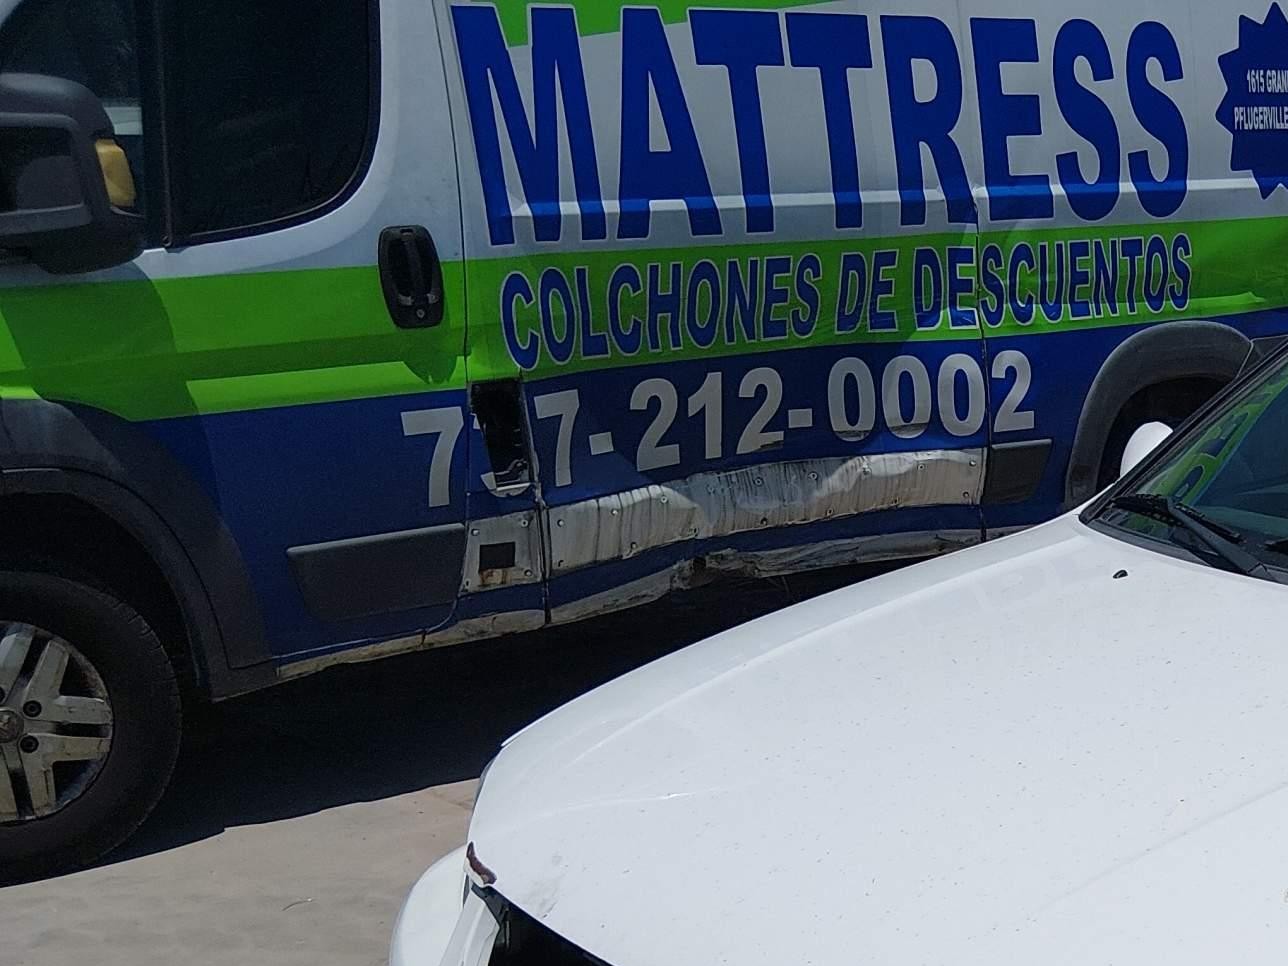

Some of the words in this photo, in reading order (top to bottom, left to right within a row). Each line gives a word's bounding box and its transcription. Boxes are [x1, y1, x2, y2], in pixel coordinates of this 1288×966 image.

[449, 4, 1190, 246] MATTRESS
[1247, 69, 1265, 93] 1615
[499, 253, 822, 371] COLCHONES
[834, 249, 899, 335] DE
[912, 233, 1193, 331] DESCUENTOS
[401, 349, 1035, 508] 77-212-0002
